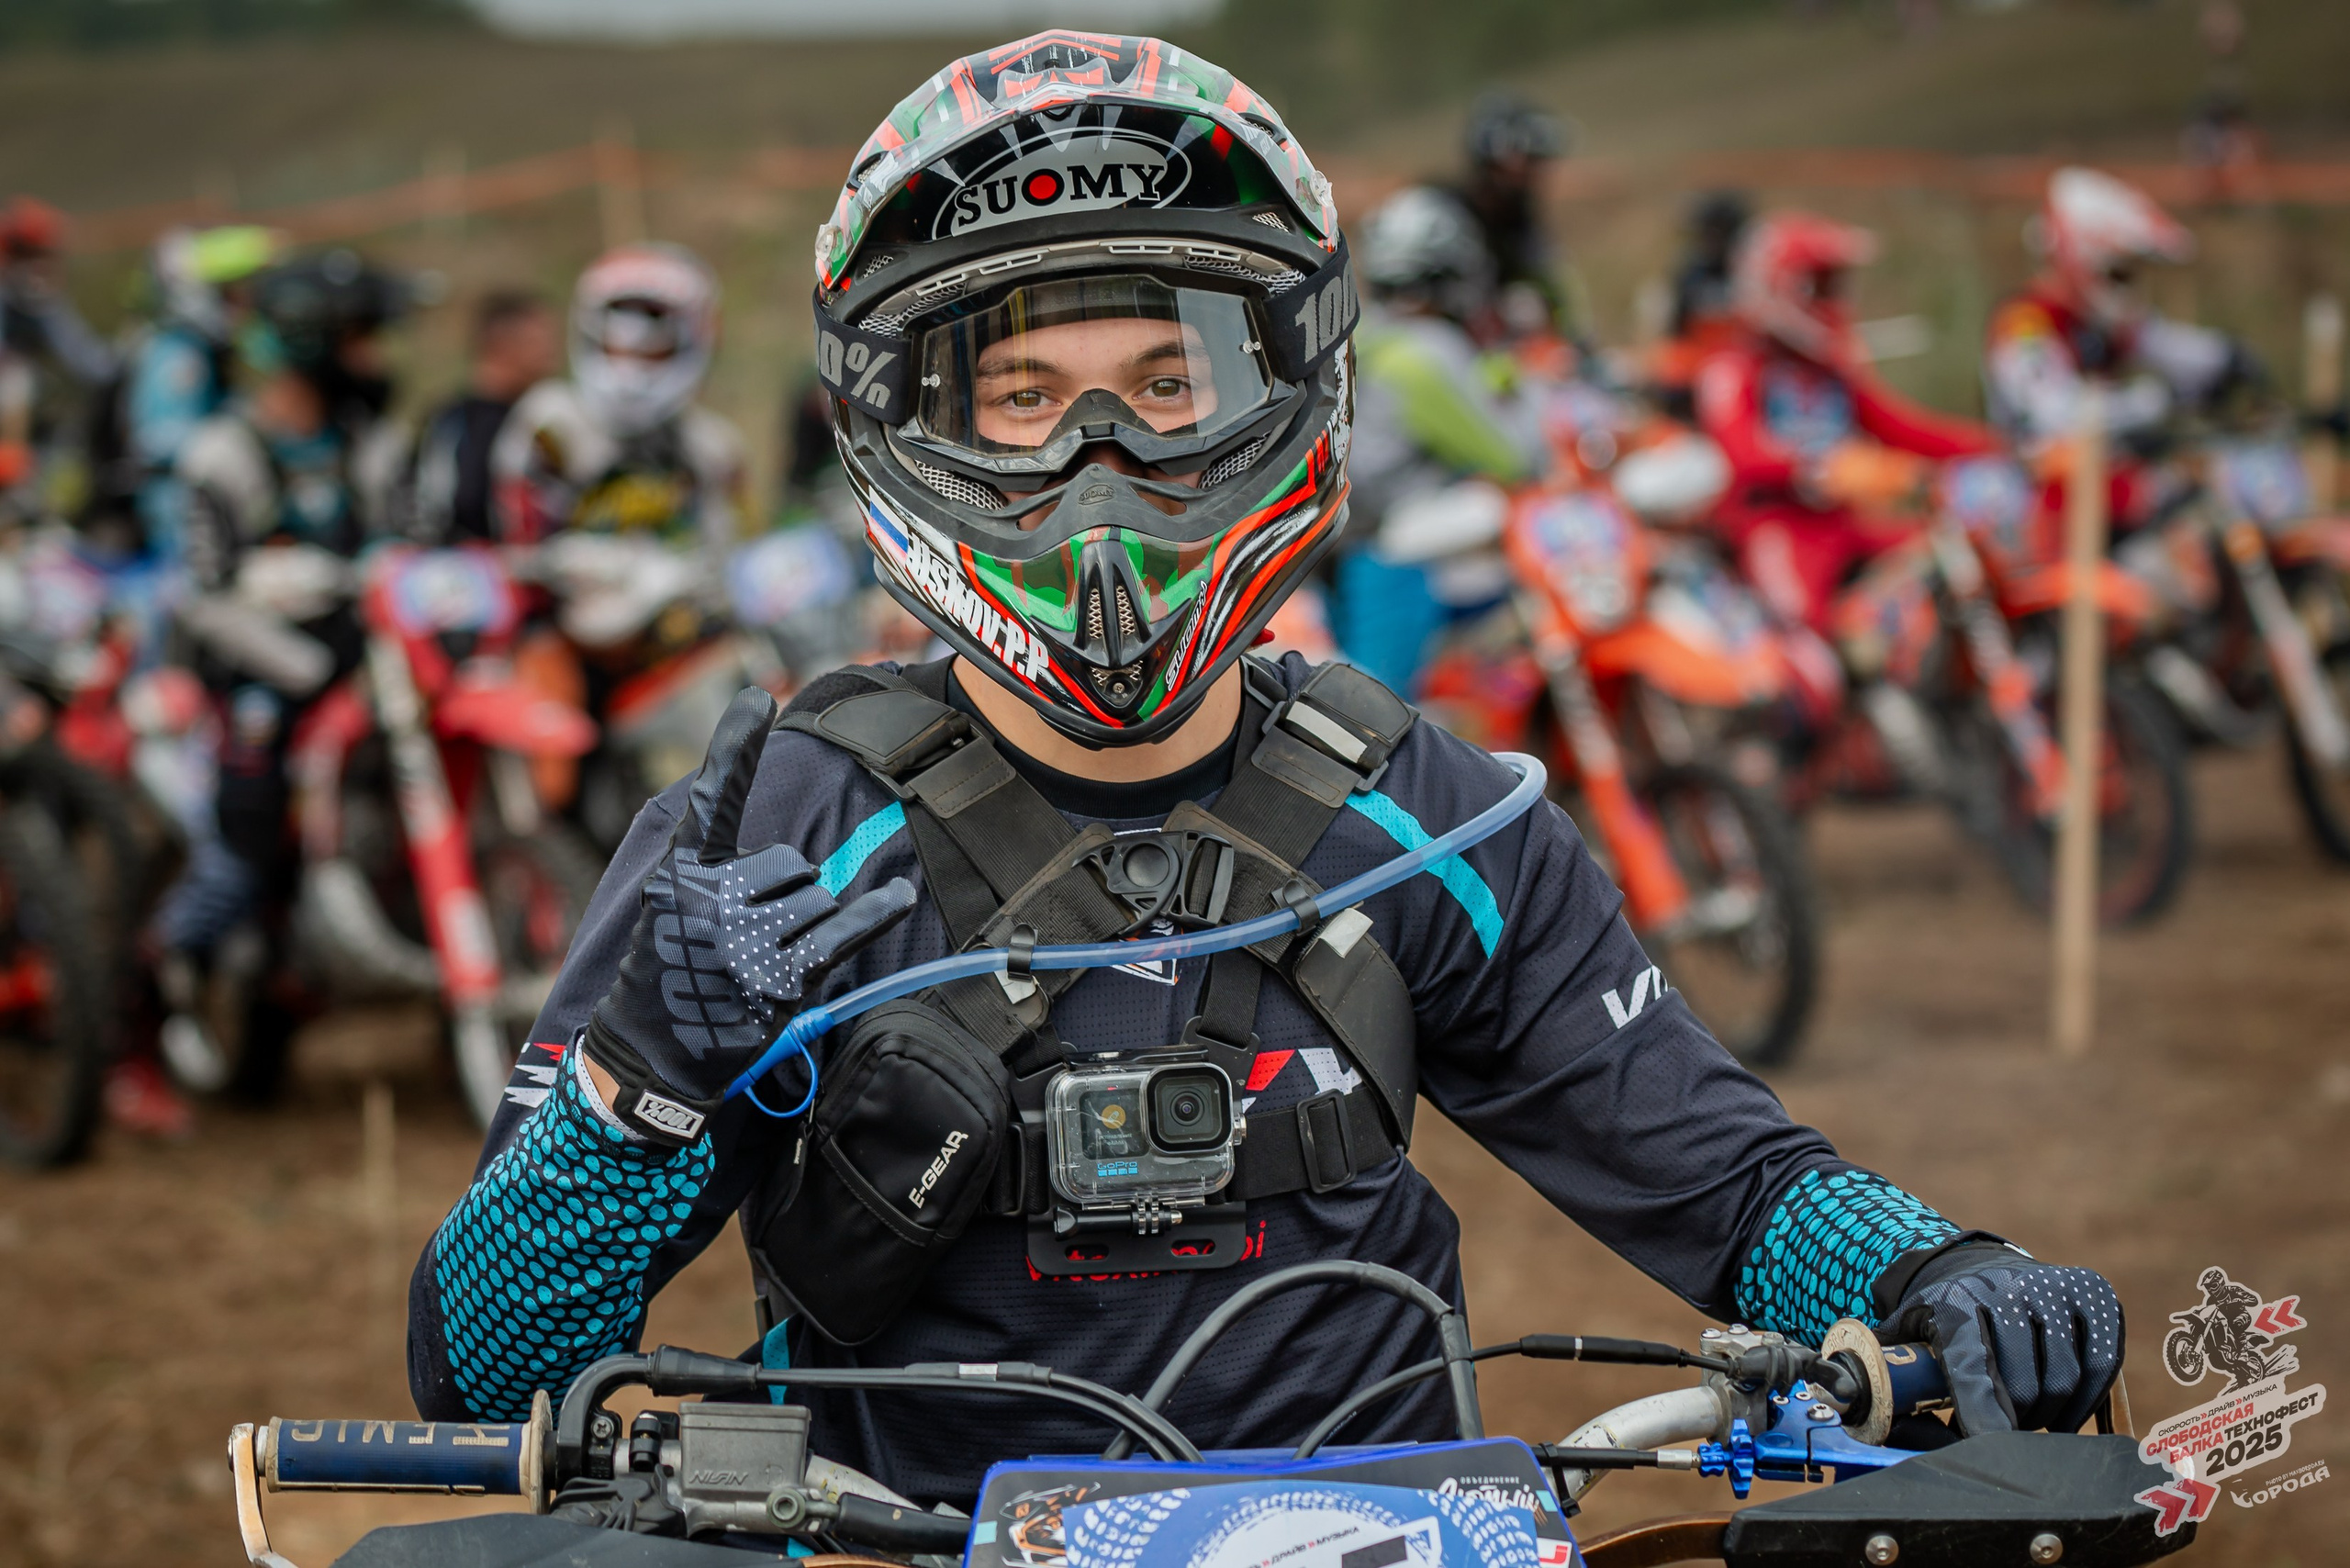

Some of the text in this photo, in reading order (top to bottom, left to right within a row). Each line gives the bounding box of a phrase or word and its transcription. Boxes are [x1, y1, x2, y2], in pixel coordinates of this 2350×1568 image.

[956, 163, 1165, 229] SUOMY
[644, 1101, 694, 1130] 100%
[908, 1129, 969, 1209] E-GEAR
[1097, 1161, 1138, 1170] GoPro
